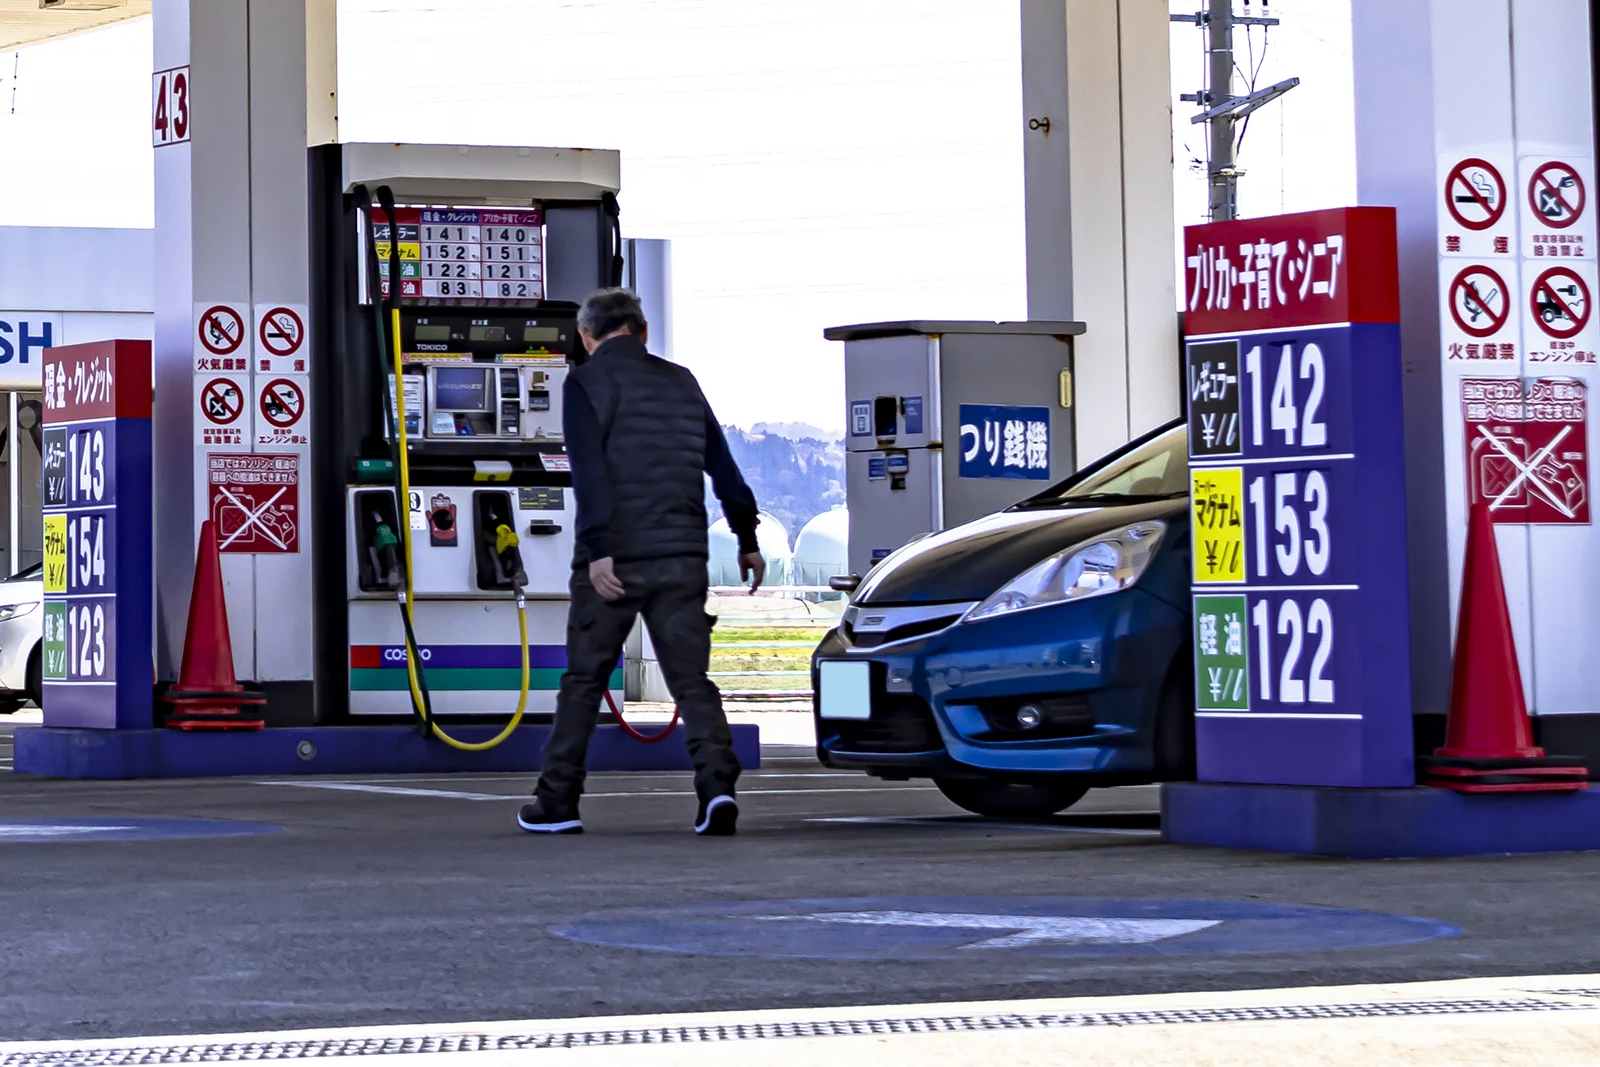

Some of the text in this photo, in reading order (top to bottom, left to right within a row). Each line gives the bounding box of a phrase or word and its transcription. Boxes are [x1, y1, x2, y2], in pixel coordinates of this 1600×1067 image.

[155, 73, 188, 141] 43
[423, 212, 478, 222] 現金・クレジット
[426, 227, 463, 240] 141
[486, 228, 525, 242] 140
[426, 245, 465, 259] 152
[486, 246, 524, 260] 151
[427, 264, 465, 277] 122
[487, 265, 524, 278] 121
[1187, 234, 1343, 312] プリカ・子育て・シニア
[441, 282, 465, 295] 83
[501, 283, 526, 297] 82
[197, 358, 246, 370] 火気厳禁
[1448, 342, 1515, 361] 火気厳禁
[1529, 351, 1596, 363] エンジン停止
[44, 357, 113, 409] 現金・クレジット
[1191, 361, 1238, 402] レギュラー
[1245, 342, 1327, 447] 142
[259, 436, 308, 444] エンジン停止
[960, 419, 1048, 470] つり銭機
[69, 430, 104, 501] 143
[1195, 493, 1241, 529] マグナム
[1249, 469, 1331, 577] 153
[69, 516, 105, 587] 154
[69, 605, 104, 676] 123
[384, 649, 432, 660] COSO
[1199, 612, 1243, 656] 軽油
[1252, 597, 1335, 704] 122
